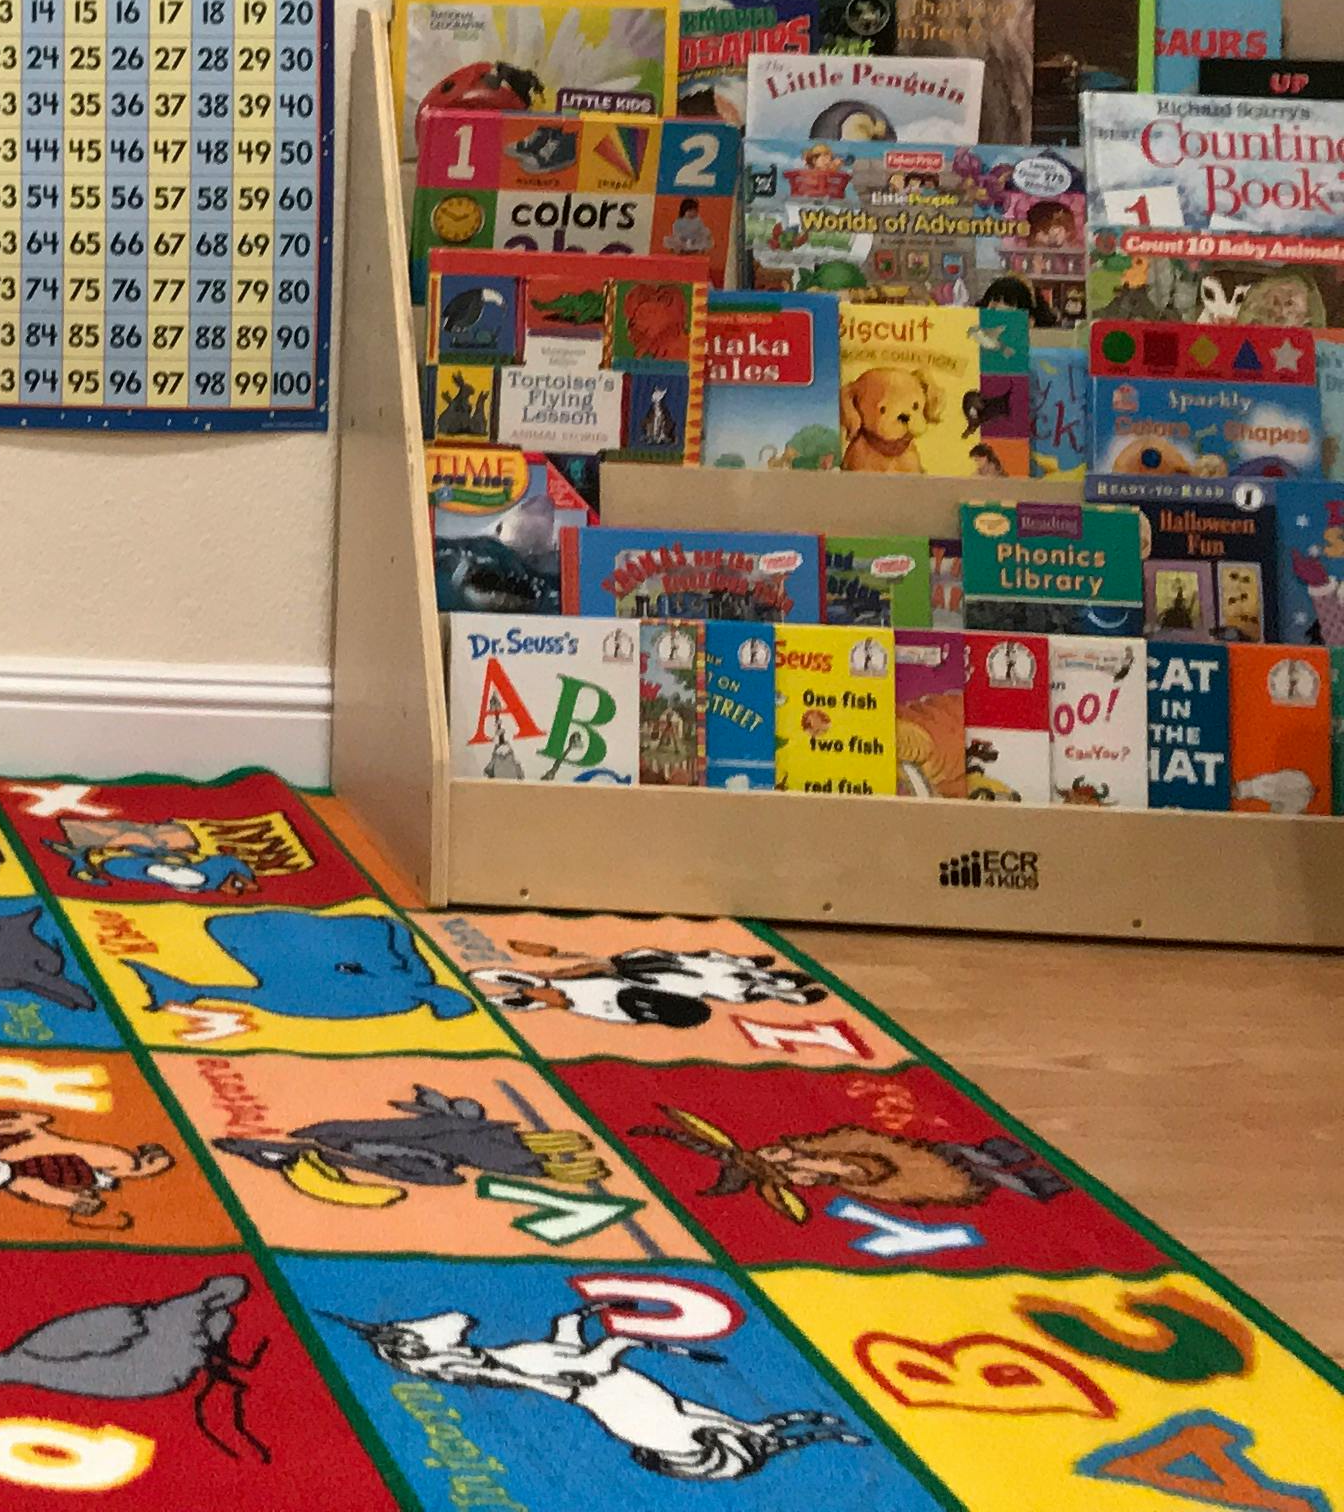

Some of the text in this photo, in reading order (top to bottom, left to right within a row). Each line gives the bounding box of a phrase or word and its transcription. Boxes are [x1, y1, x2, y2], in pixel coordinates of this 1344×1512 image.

[765, 60, 966, 105] Little Penguin
[561, 92, 653, 113] LITTLE KIDS
[1157, 101, 1231, 118] Richard
[446, 124, 476, 180] 1
[674, 133, 721, 187] 2
[1199, 164, 1335, 217] Book
[511, 194, 638, 229] colors
[800, 209, 1031, 237] Worlds of Adventure
[1126, 237, 1184, 253] Count
[1186, 238, 1213, 255] 10
[1218, 239, 1266, 258] Baby
[705, 331, 790, 357] taka
[507, 370, 614, 392] Tortoise's
[708, 358, 780, 381] ales
[527, 390, 594, 411] Flying
[1168, 389, 1253, 414] Sparkly
[520, 407, 598, 425] Lesson
[1224, 420, 1310, 446] Shapes
[428, 455, 514, 477] TIME
[1160, 509, 1256, 535] Halloween
[996, 543, 1106, 568] Phonics
[1186, 534, 1225, 556] Fun
[1000, 568, 1104, 597] Library
[467, 627, 579, 660] Dr. Seuss's
[775, 640, 833, 672] Seuss
[803, 689, 877, 709] One fish
[1161, 698, 1191, 719] IN
[848, 736, 884, 755] fish
[1149, 723, 1201, 745] THE
[804, 780, 873, 795] red fish
[983, 850, 1038, 872] ECR
